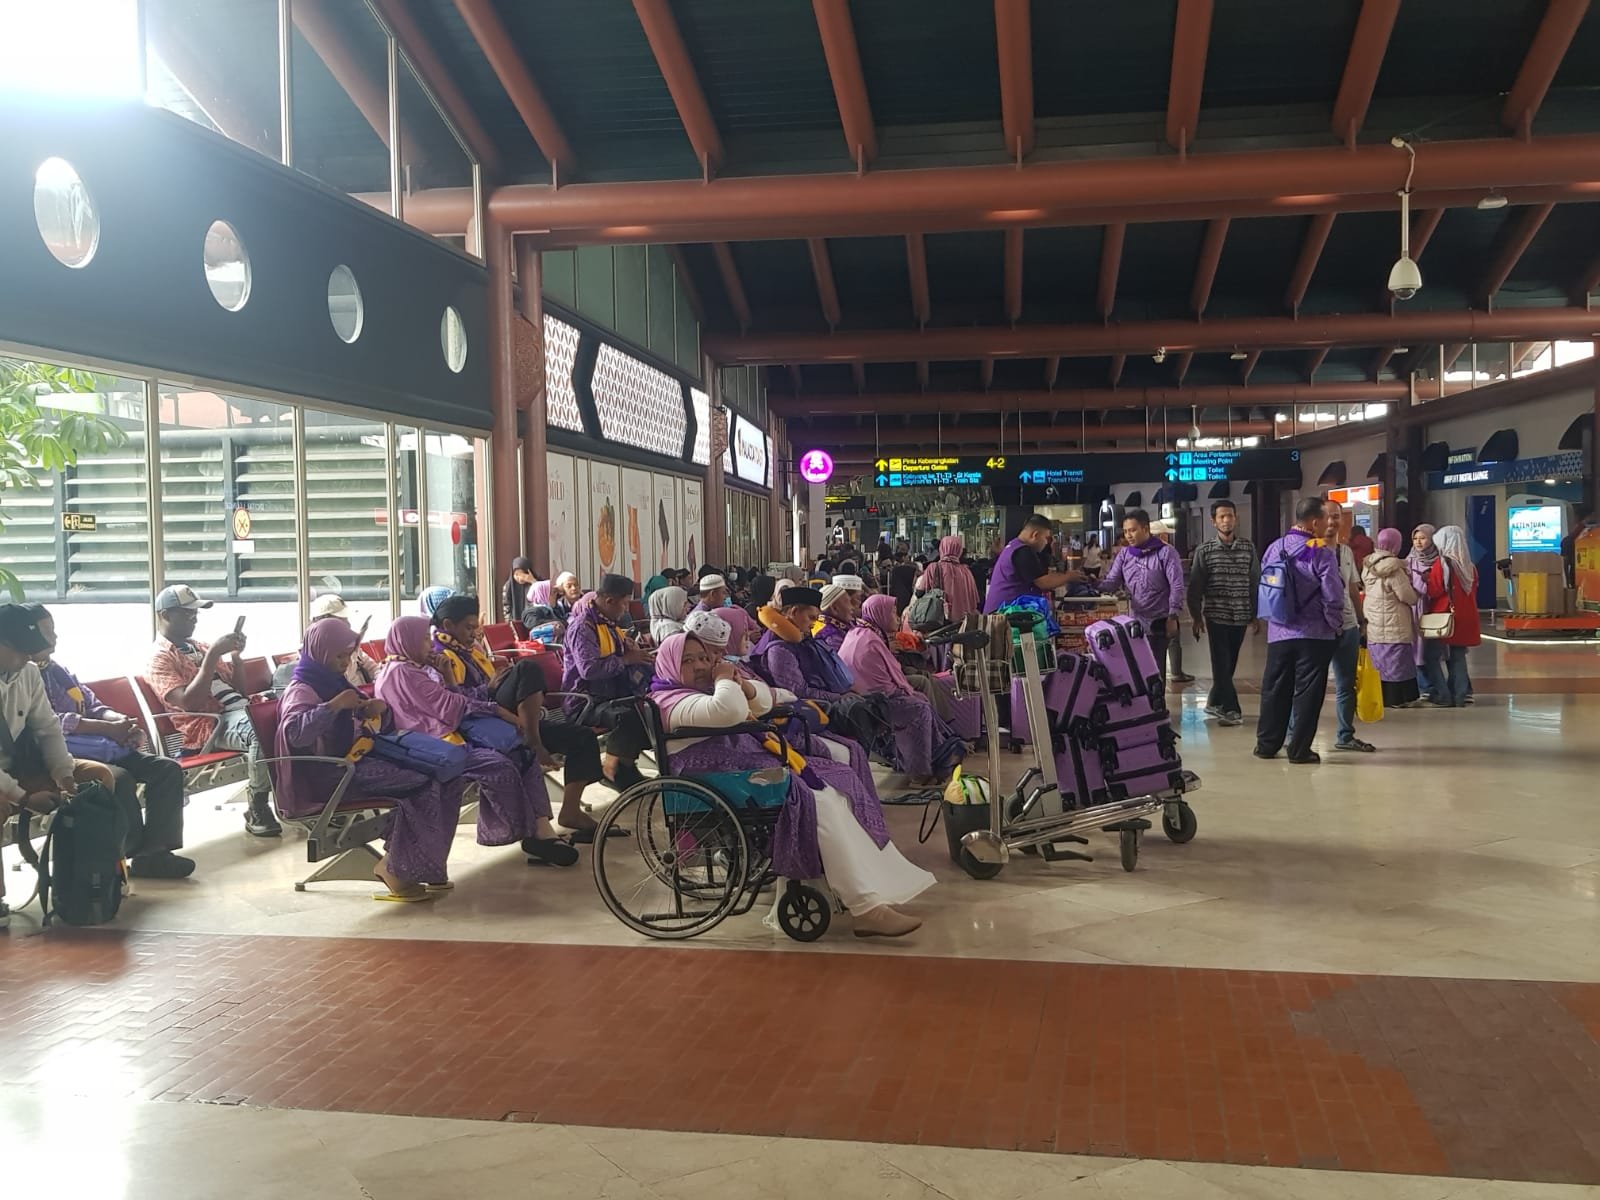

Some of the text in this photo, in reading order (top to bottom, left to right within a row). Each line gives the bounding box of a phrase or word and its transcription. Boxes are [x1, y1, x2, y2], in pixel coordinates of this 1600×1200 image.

[1291, 450, 1299, 461] 3
[986, 457, 1006, 469] 4-2
[1193, 458, 1216, 466] Meeting
